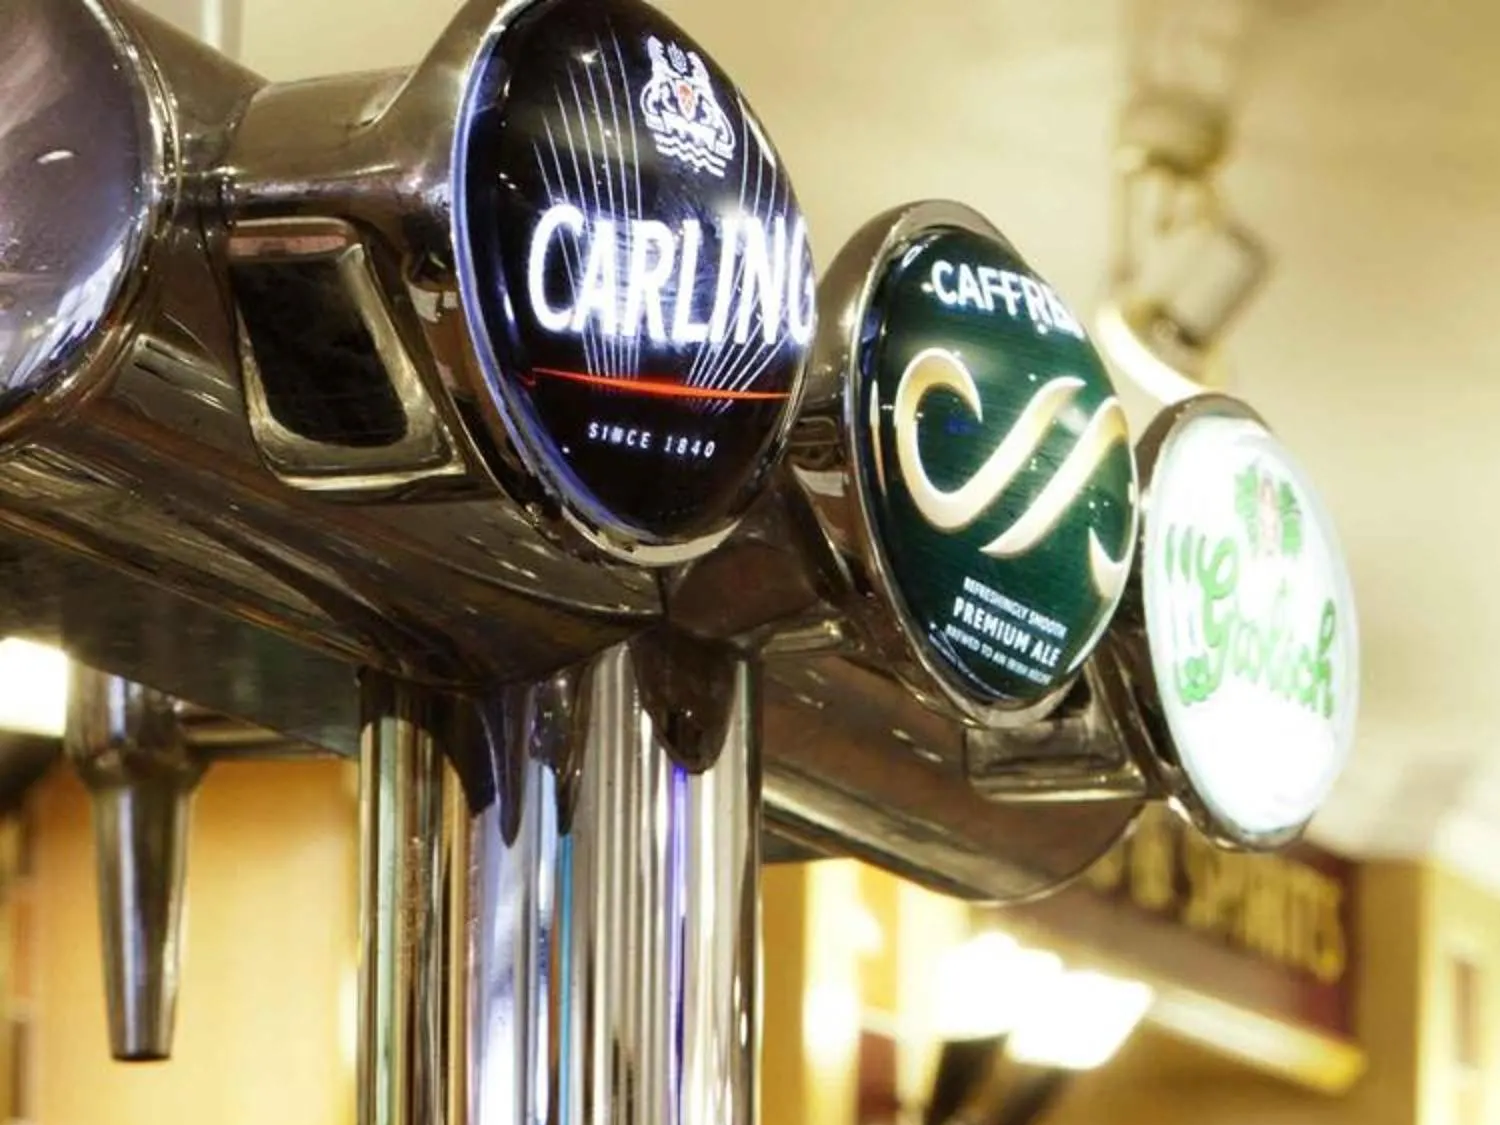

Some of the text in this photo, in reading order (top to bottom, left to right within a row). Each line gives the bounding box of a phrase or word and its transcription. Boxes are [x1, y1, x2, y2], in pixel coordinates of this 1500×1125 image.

[528, 203, 817, 345] CARLING
[588, 421, 716, 459] SINCE 1840
[952, 595, 1063, 668] PREMIUM ALE
